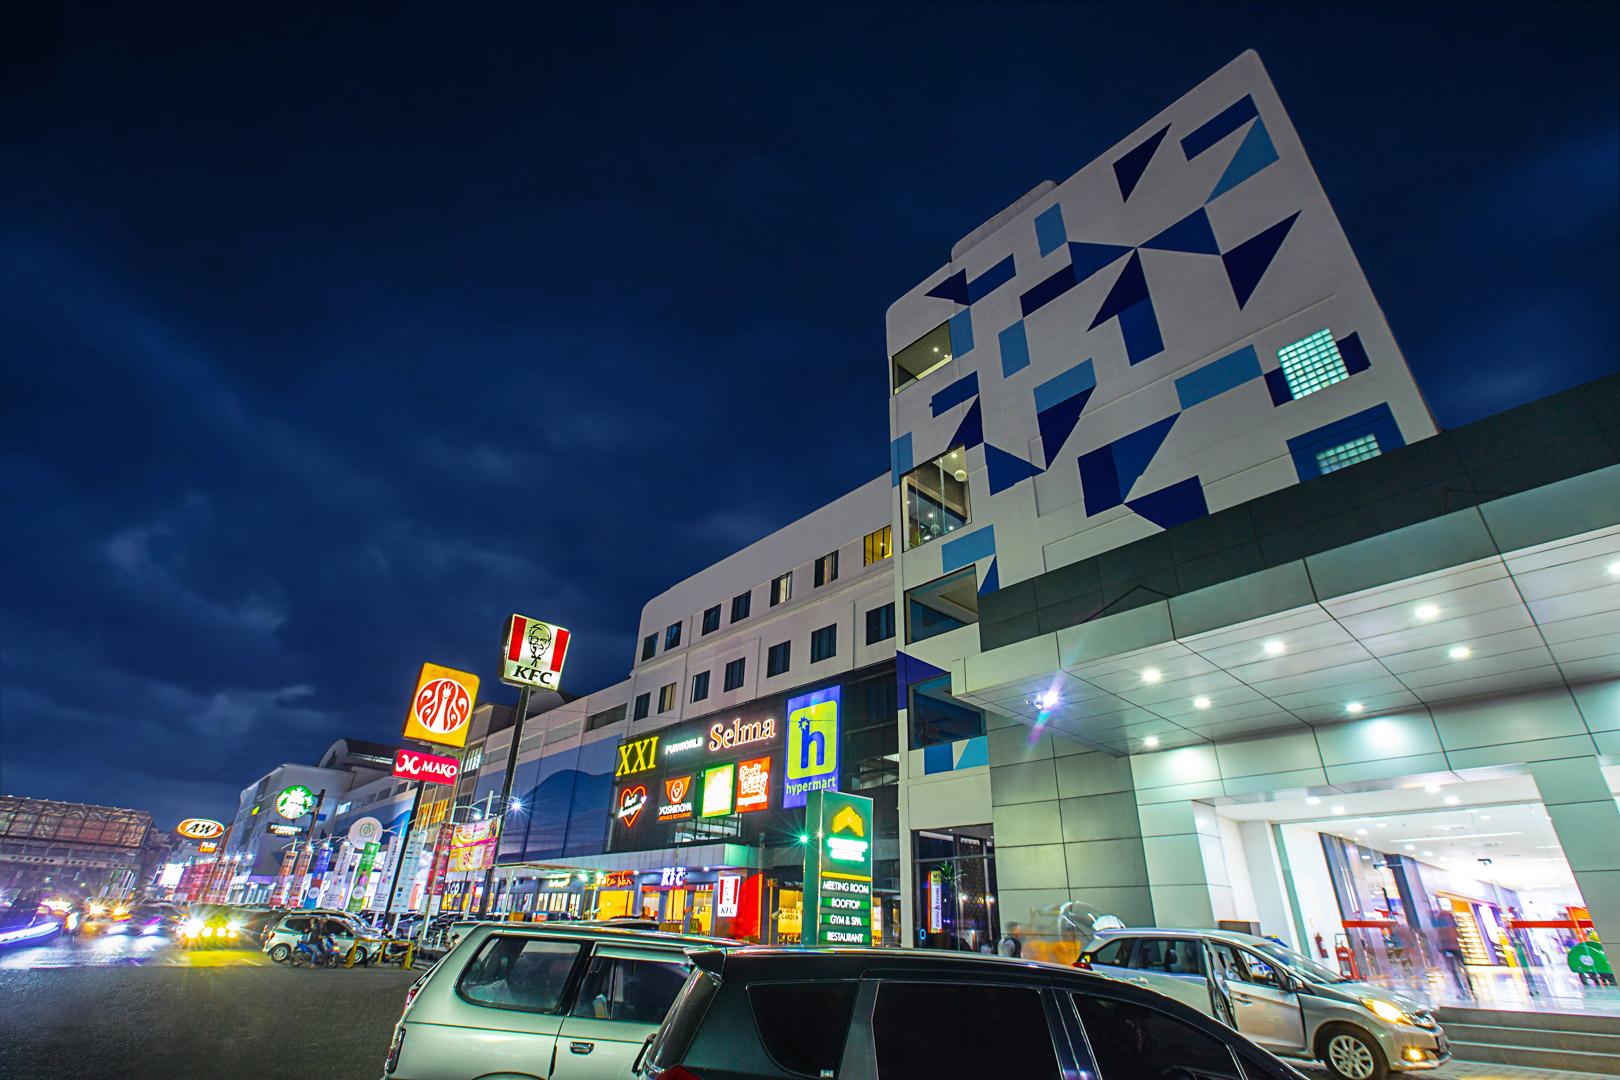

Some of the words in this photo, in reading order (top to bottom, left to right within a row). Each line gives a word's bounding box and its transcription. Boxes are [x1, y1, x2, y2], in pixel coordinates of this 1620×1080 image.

[513, 665, 552, 685] KFC
[709, 718, 776, 751] Selma
[616, 736, 659, 776] XXI
[421, 760, 457, 778] MAKO
[786, 777, 836, 795] hypermart
[661, 867, 686, 886] KFC
[822, 880, 849, 891] MEETING
[850, 883, 869, 894] ROOM
[831, 897, 860, 909] ROOFTOP
[830, 914, 845, 925] GYM
[845, 915, 851, 925] &
[851, 916, 862, 926] SPA
[827, 931, 863, 943] RESTAURANT
